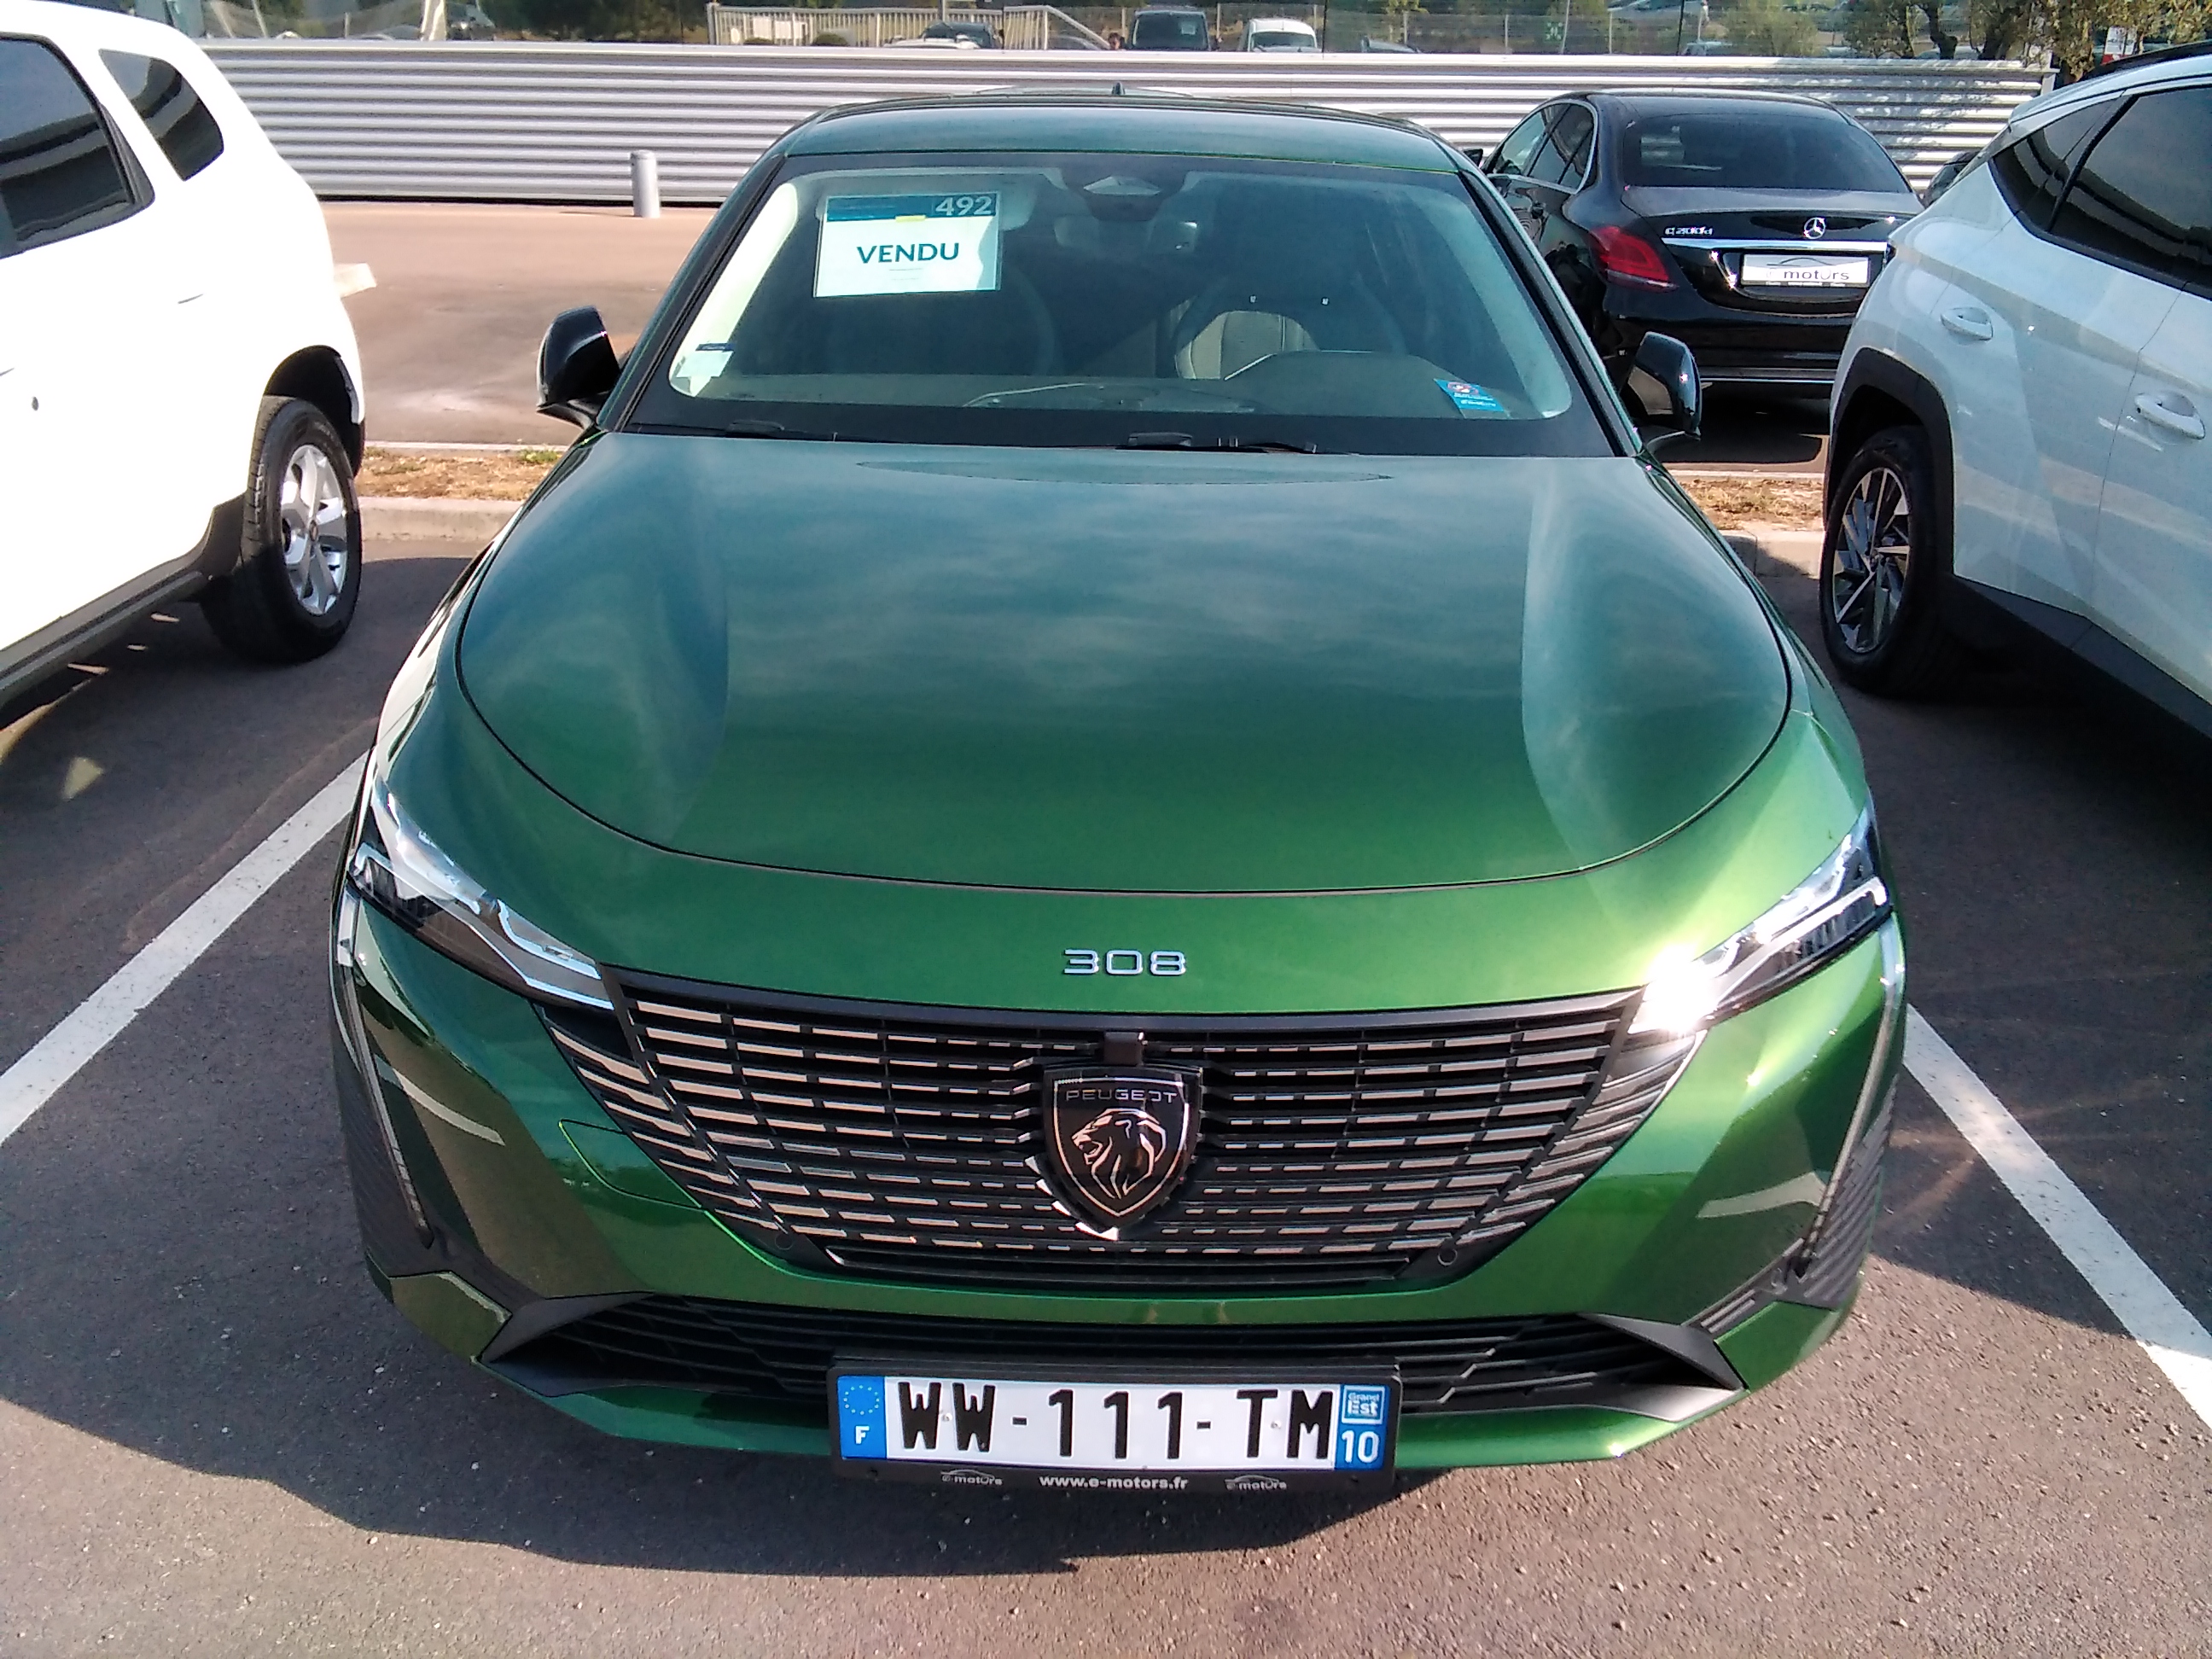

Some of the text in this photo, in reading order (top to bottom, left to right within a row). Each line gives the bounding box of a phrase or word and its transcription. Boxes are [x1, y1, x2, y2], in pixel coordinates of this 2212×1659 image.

[935, 196, 992, 216] 492
[856, 242, 960, 264] VENDU
[1063, 949, 1186, 975] 308
[1066, 1089, 1178, 1103] PEUGEOT
[1347, 1400, 1378, 1417] Est
[855, 1425, 870, 1445] F
[1342, 1429, 1380, 1464] 10
[1039, 1475, 1189, 1490] www.e-motors.fr
